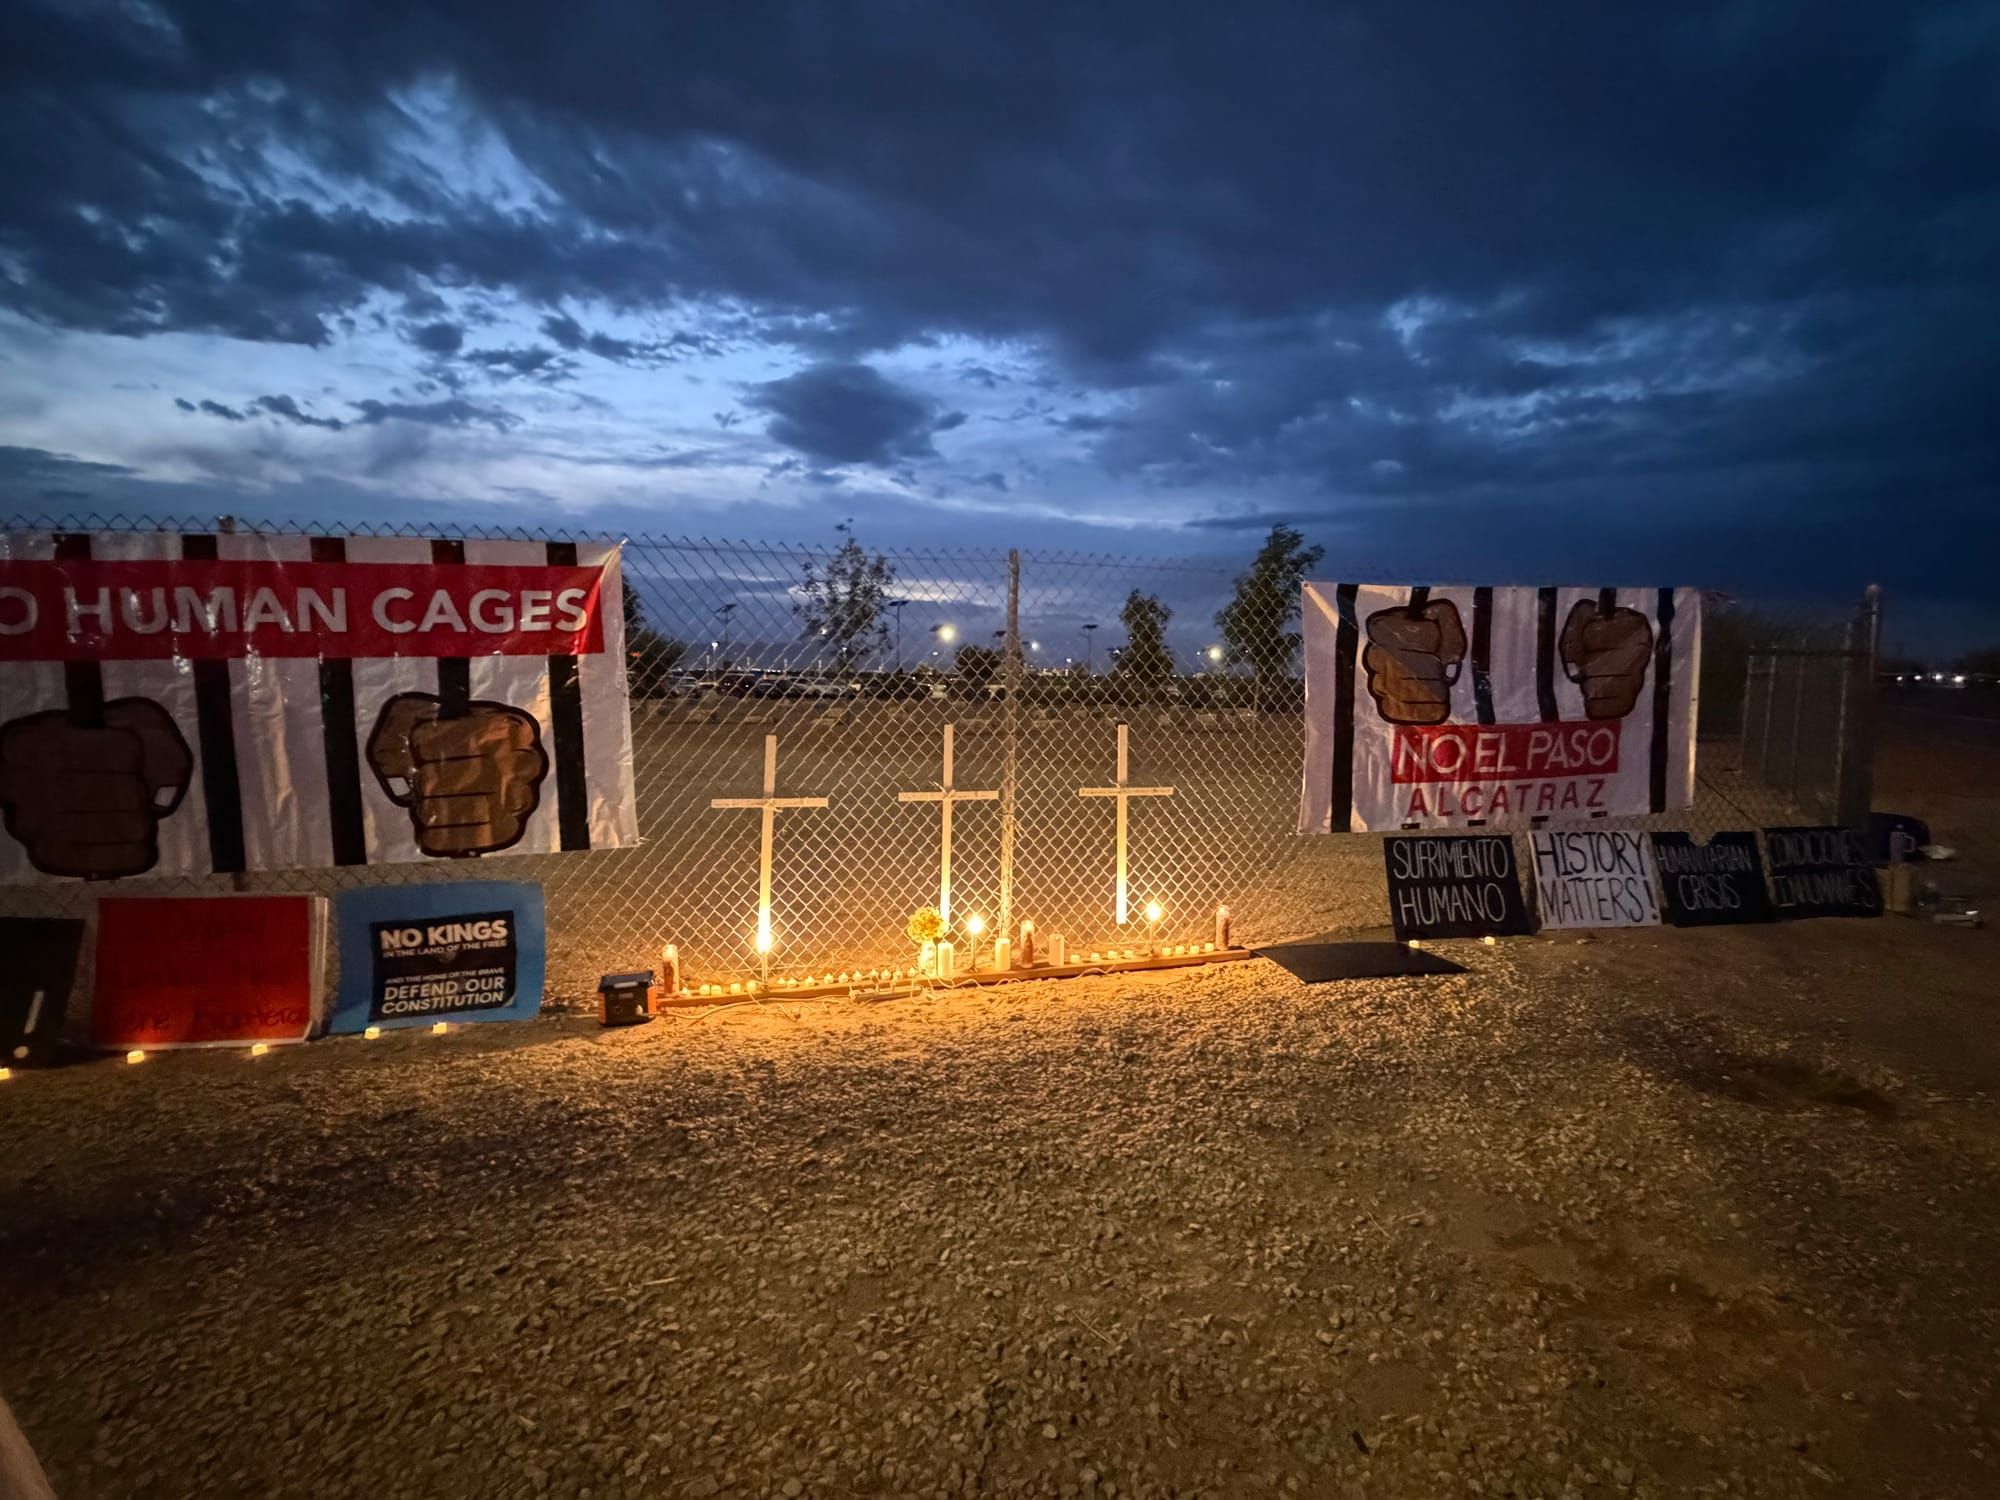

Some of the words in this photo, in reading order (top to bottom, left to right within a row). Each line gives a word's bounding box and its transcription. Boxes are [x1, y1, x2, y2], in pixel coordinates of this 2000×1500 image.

[0, 586, 39, 636] O
[63, 585, 348, 636] HUMAN
[371, 586, 589, 634] CAGES
[1396, 733, 1468, 776] NO
[1473, 731, 1517, 774] EL
[1526, 727, 1617, 771] PASO
[1406, 778, 1606, 818] ALCATRAZ
[1392, 838, 1509, 880] SUFRIMIENTO
[1532, 831, 1650, 878] HISTORY
[1397, 881, 1507, 927] HUMANO
[1540, 876, 1659, 923] MATTERS!
[1678, 871, 1742, 911] CRISIS
[379, 926, 424, 951] NO
[426, 918, 509, 946] KINGS
[417, 946, 445, 956] LAND
[446, 943, 460, 952] OF
[462, 942, 481, 950] THE
[482, 939, 508, 948] FREE
[381, 990, 504, 1015] CONSTITUTION
[384, 979, 459, 1001] DEFEND
[465, 975, 505, 992] OUR
